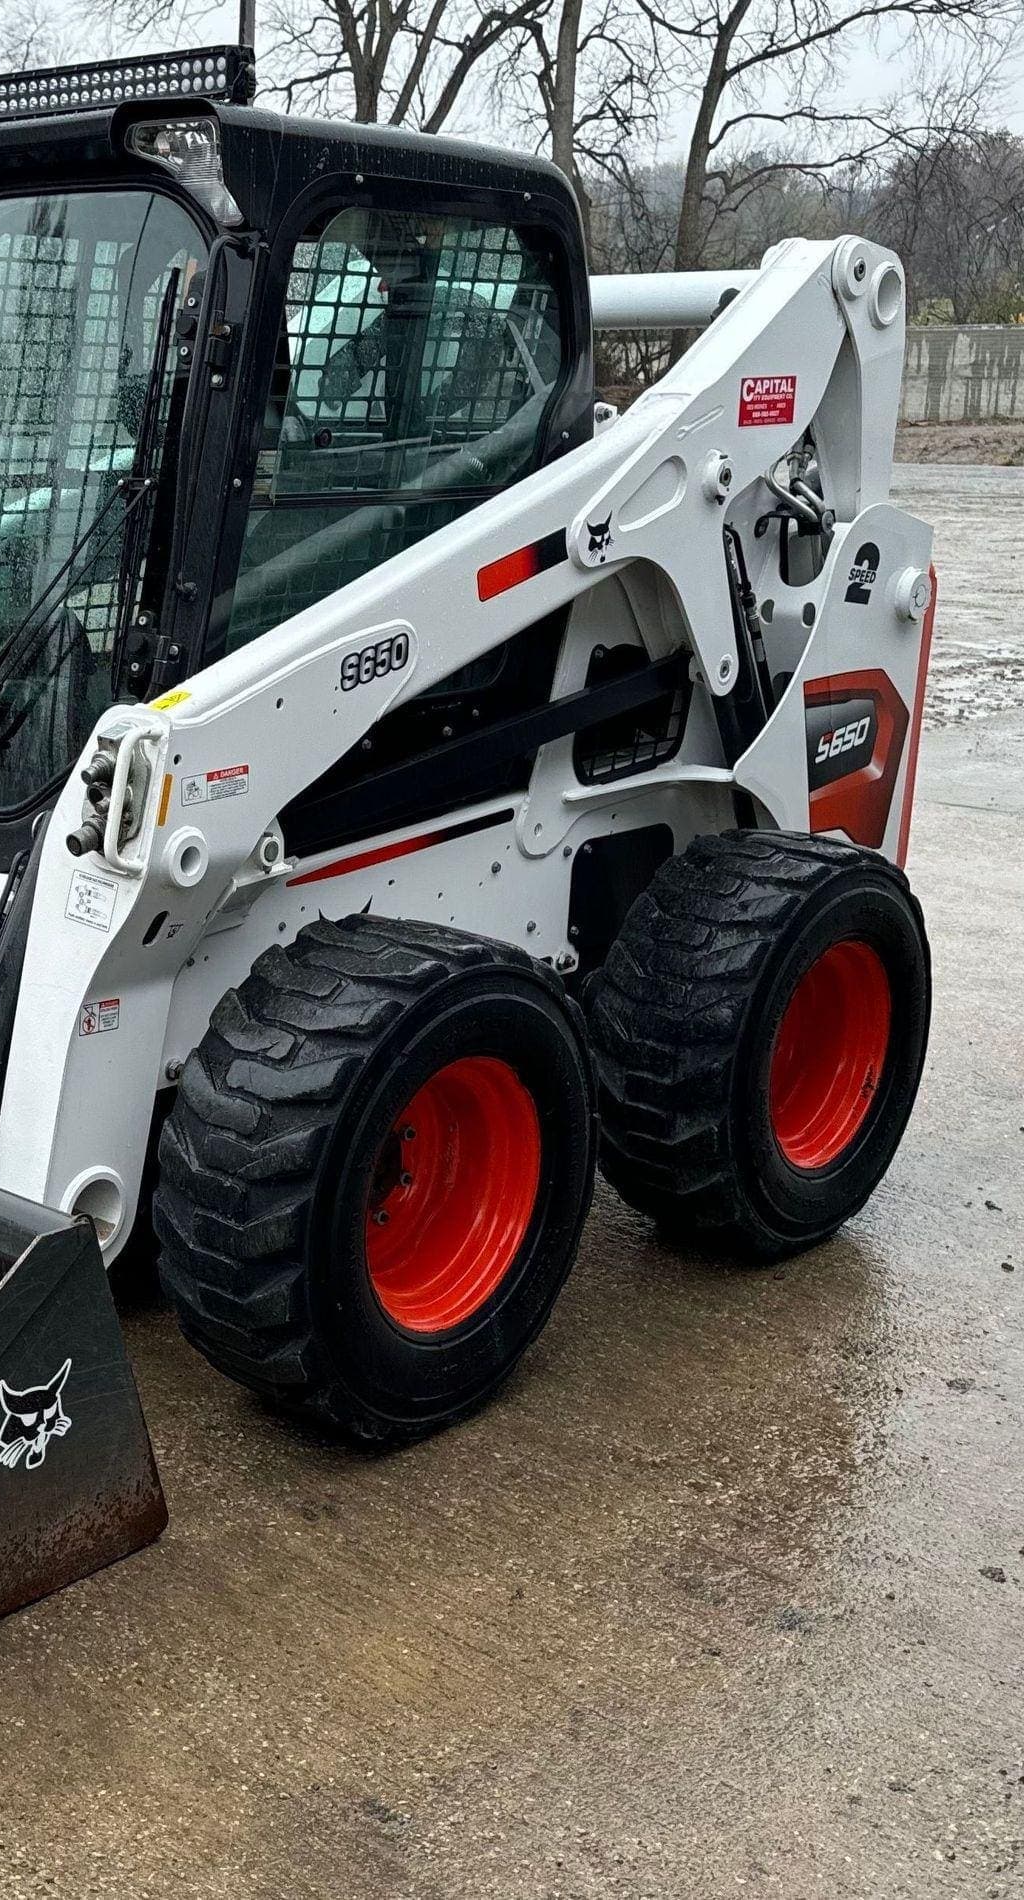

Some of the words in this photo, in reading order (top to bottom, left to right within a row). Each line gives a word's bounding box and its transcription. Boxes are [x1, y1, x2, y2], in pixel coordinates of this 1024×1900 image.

[742, 378, 794, 402] CAPITAL
[844, 542, 880, 605] 2
[848, 568, 876, 584] SPEED
[341, 633, 409, 691] S650
[815, 716, 871, 764] S650
[220, 767, 244, 778] DANGER
